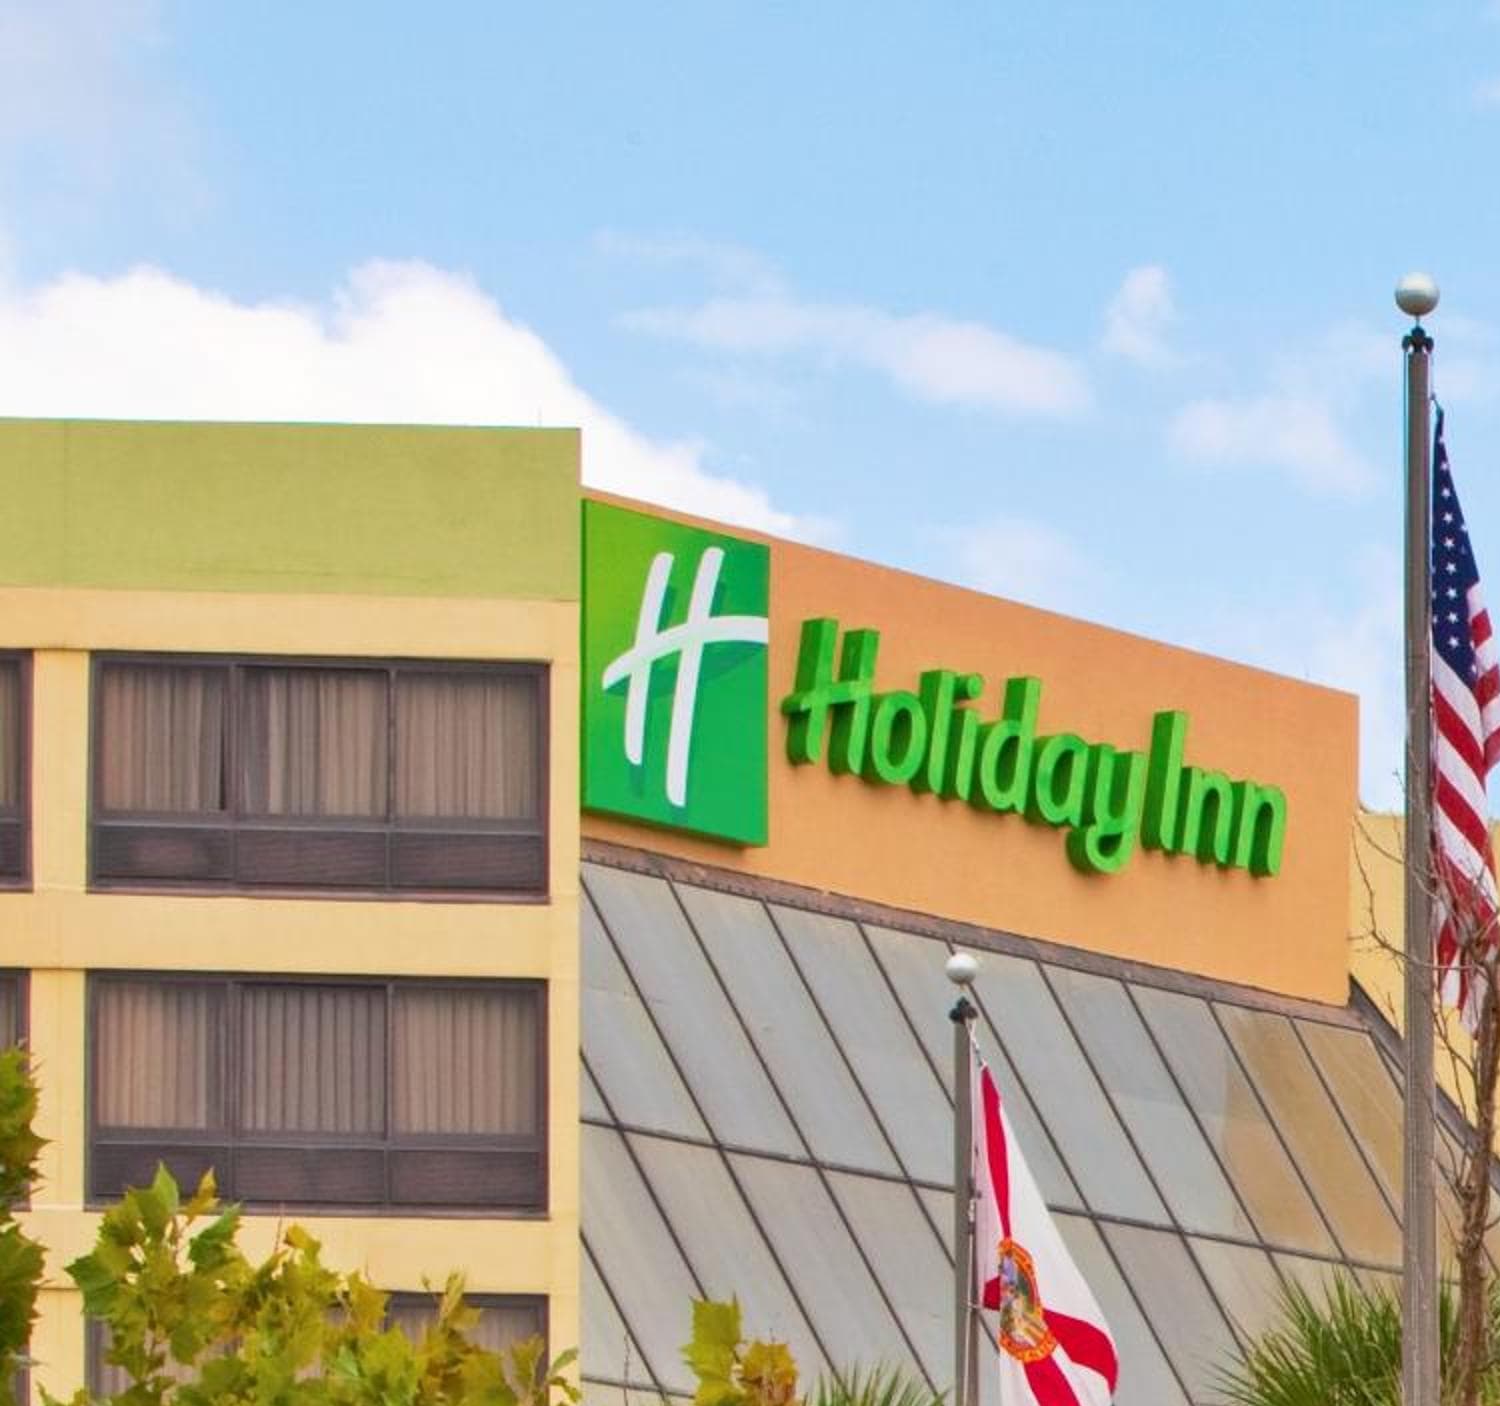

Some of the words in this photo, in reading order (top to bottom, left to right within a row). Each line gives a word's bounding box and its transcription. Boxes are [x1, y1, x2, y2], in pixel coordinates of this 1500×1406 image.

[602, 546, 769, 807] H
[781, 617, 1144, 875] Holiday
[1141, 711, 1287, 878] Inn
